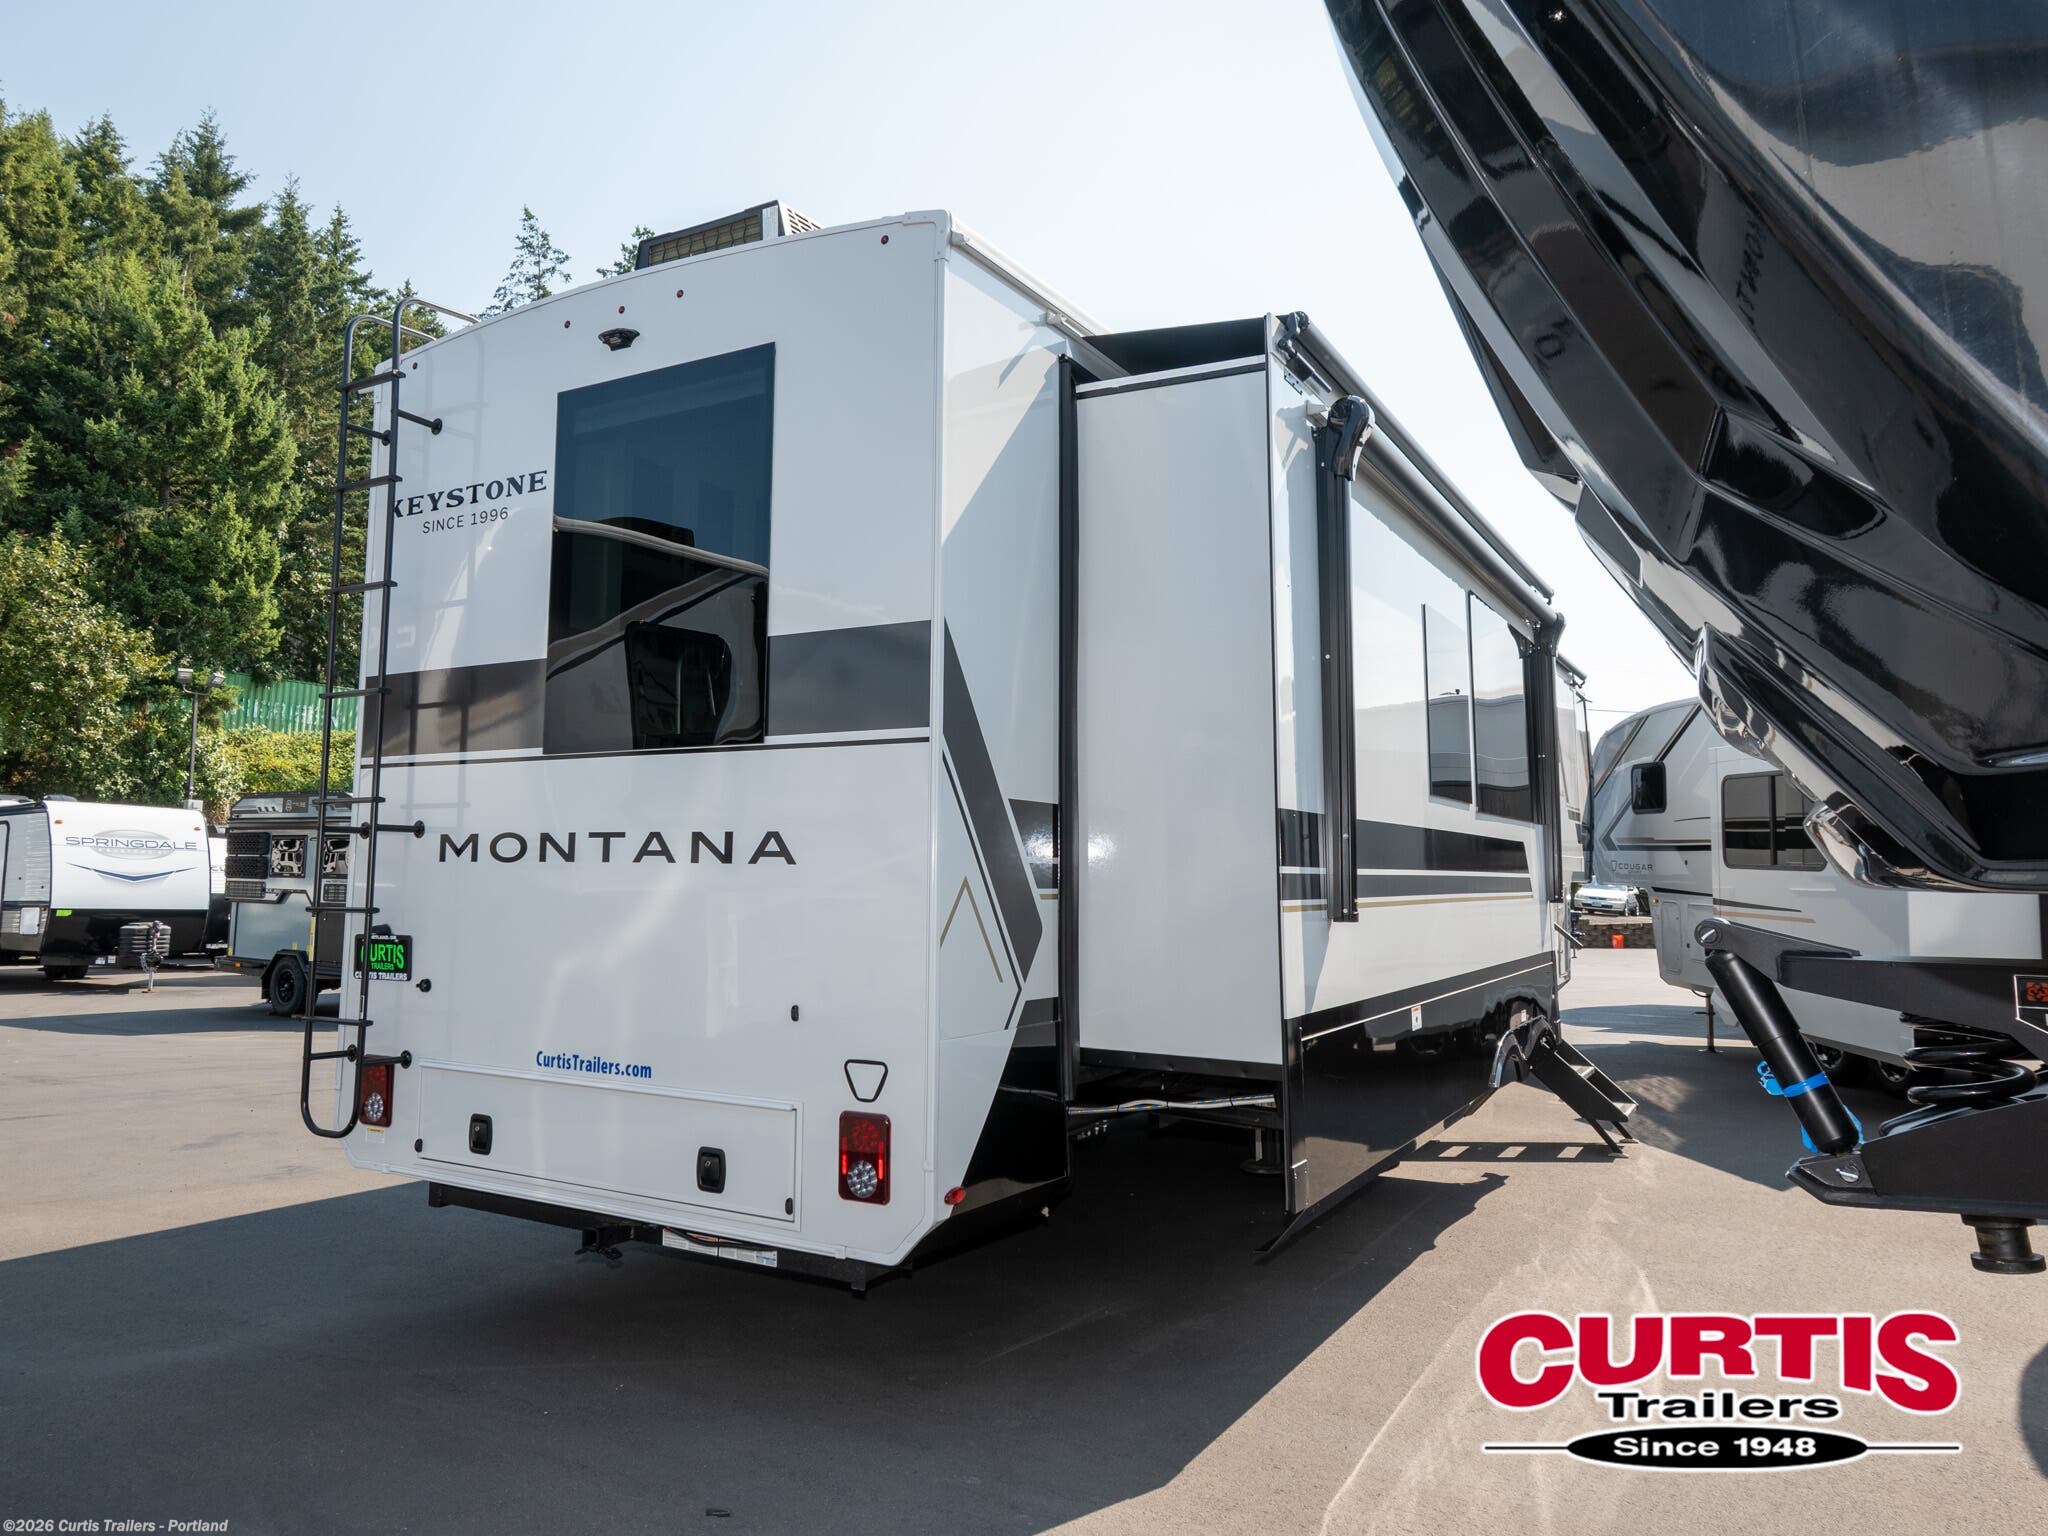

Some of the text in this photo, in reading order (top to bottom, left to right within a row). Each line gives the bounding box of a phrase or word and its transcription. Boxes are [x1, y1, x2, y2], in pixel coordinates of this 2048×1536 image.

[394, 470, 548, 519] KEYSTONE
[422, 507, 509, 534] SINCE 1996
[65, 836, 198, 851] SPRINGDALE
[438, 830, 797, 866] MONTANA
[1617, 862, 1654, 872] COUGAR
[535, 1049, 653, 1079] CurtisTrailers.com
